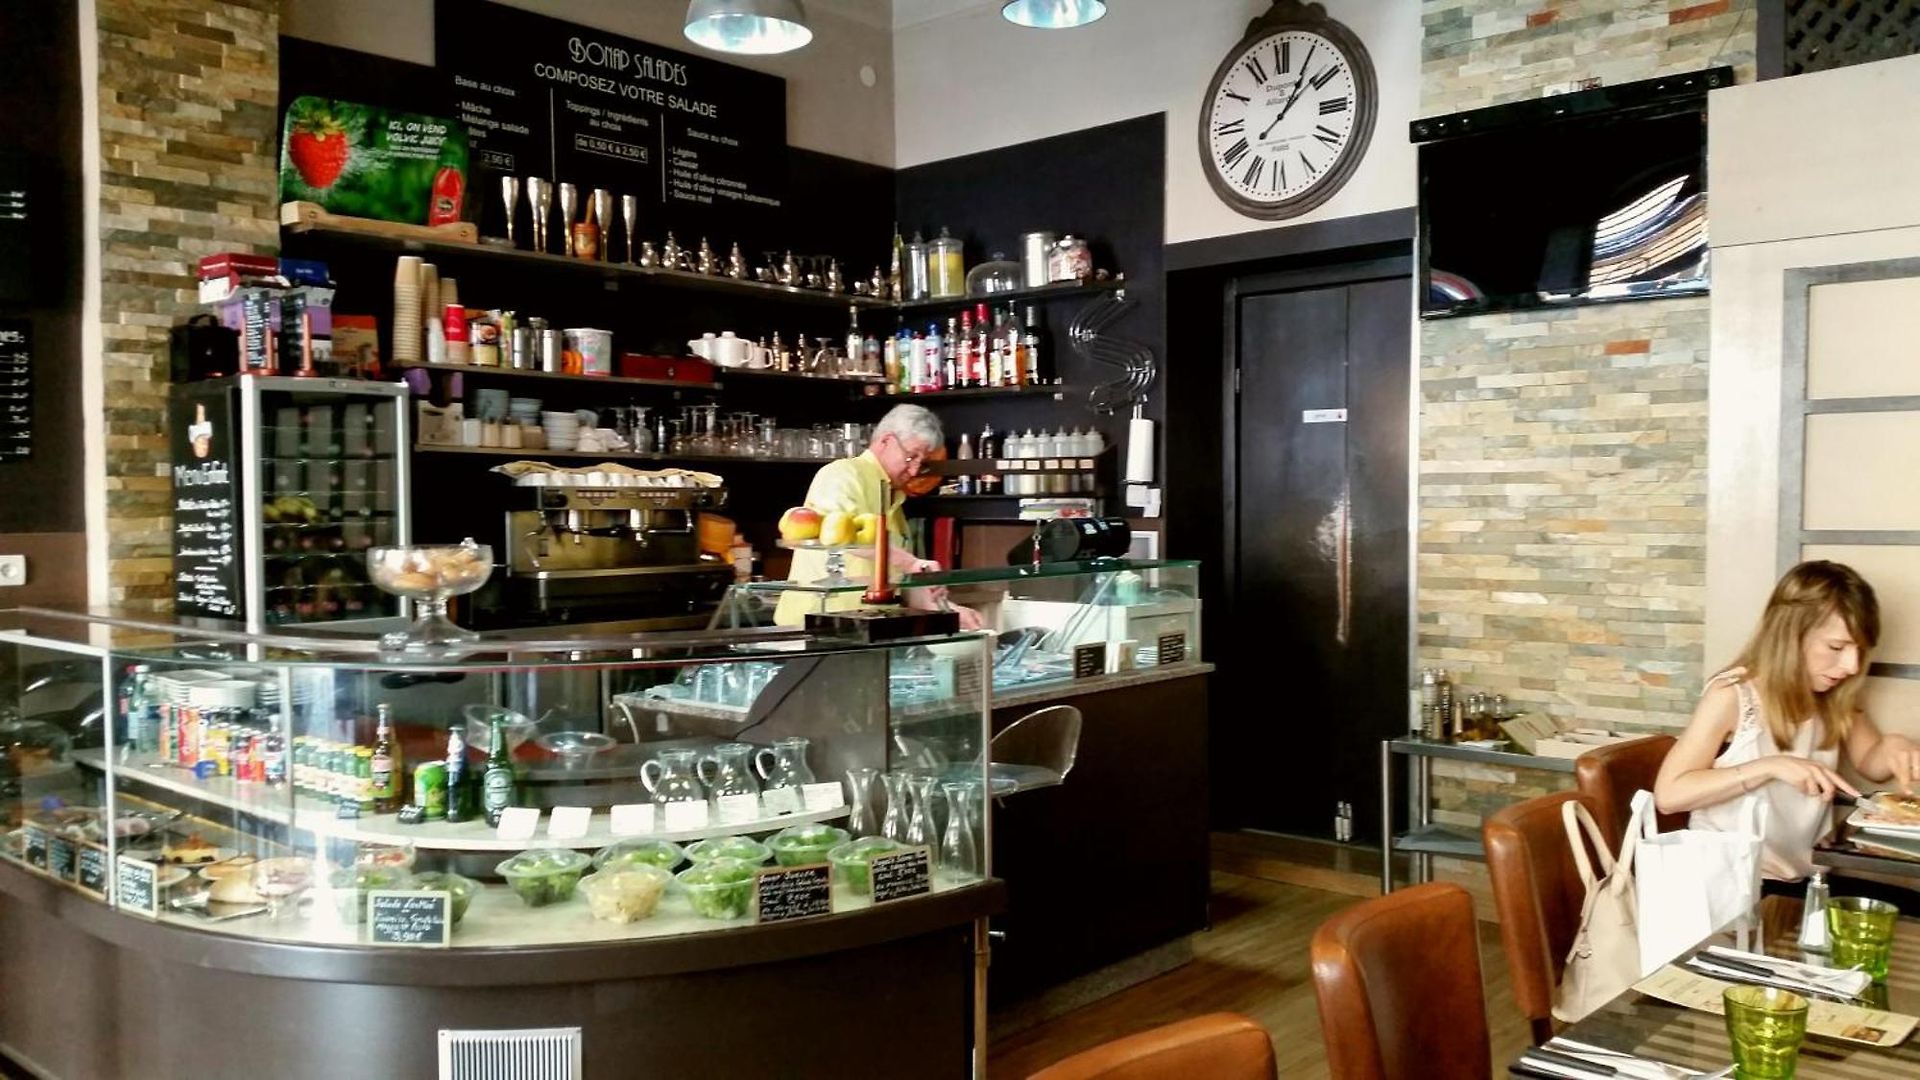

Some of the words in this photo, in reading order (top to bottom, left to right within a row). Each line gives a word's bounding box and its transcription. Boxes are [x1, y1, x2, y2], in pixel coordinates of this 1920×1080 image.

[569, 37, 630, 71] BONAP
[634, 54, 688, 86] SALADES
[455, 75, 478, 89] Base
[480, 82, 492, 92] au
[493, 85, 516, 97] choix
[534, 62, 616, 95] COMPOSEZ
[619, 83, 665, 107] VOTRE
[668, 95, 718, 119] SALADE
[461, 100, 492, 116] Mâche
[566, 99, 601, 117] Toppings
[423, 124, 448, 135] VEND
[461, 113, 500, 130] Mélange
[501, 122, 530, 135] salade
[687, 127, 710, 140] Sauce
[673, 168, 692, 180] Huile
[673, 178, 692, 190] Huile
[674, 189, 697, 201] Sauce
